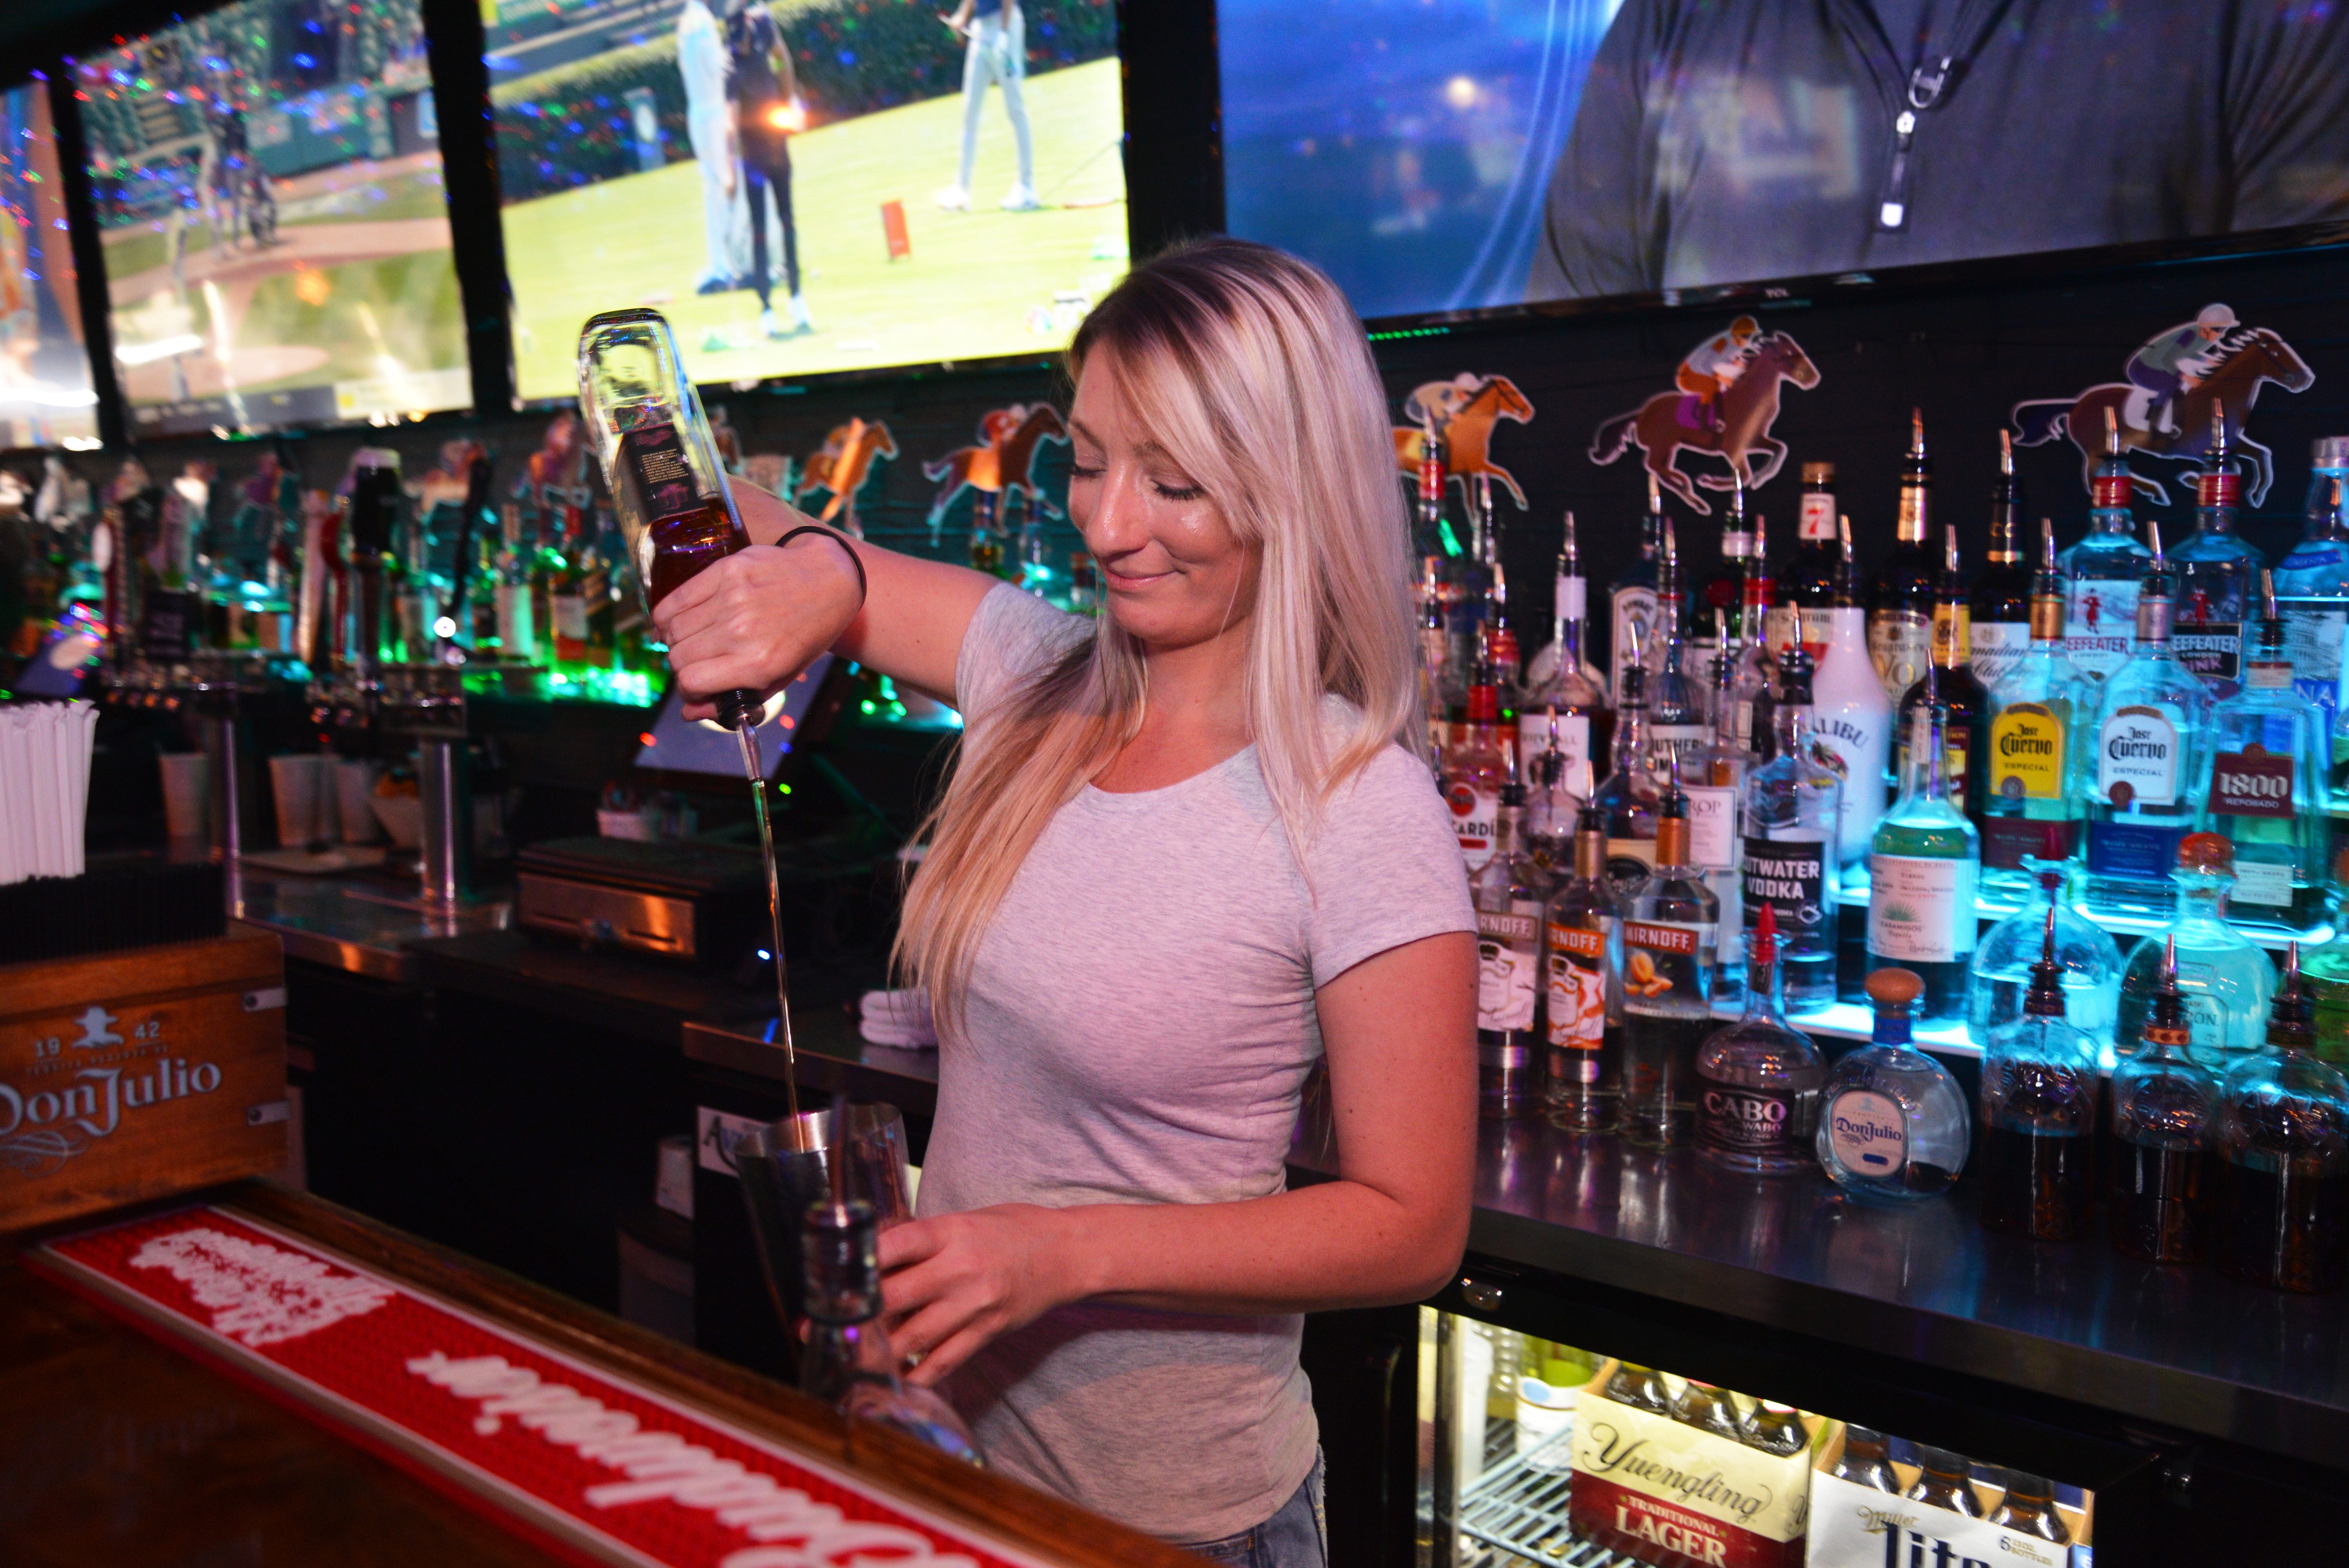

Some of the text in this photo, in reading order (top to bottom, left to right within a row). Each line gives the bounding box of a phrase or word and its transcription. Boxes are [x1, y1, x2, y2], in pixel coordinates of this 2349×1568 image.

[2065, 636, 2129, 655] EEFEATER
[2172, 635, 2240, 654] EEFEATER
[2000, 732, 2053, 757] Cuervo
[2108, 736, 2167, 761] Cuervo
[2005, 763, 2050, 772] ESPECIAL
[2113, 767, 2164, 777] ESPECIAL
[2219, 772, 2288, 798] 1800
[2226, 798, 2279, 809] REPOSADO
[1743, 856, 1820, 879] UTWATER
[1748, 877, 1804, 900] VODKA
[1480, 916, 1529, 934] RNOFF
[1626, 927, 1690, 950] MIRNOFF
[35, 1021, 160, 1057] 19 42
[1704, 1091, 1788, 1123] CABO
[1583, 1422, 1773, 1524] Yuengling
[1627, 1495, 1720, 1536] TRADITIONAL
[1858, 1506, 1920, 1534] Miller
[1615, 1504, 1727, 1568] LAGER
[2000, 1535, 2011, 1551] 6
